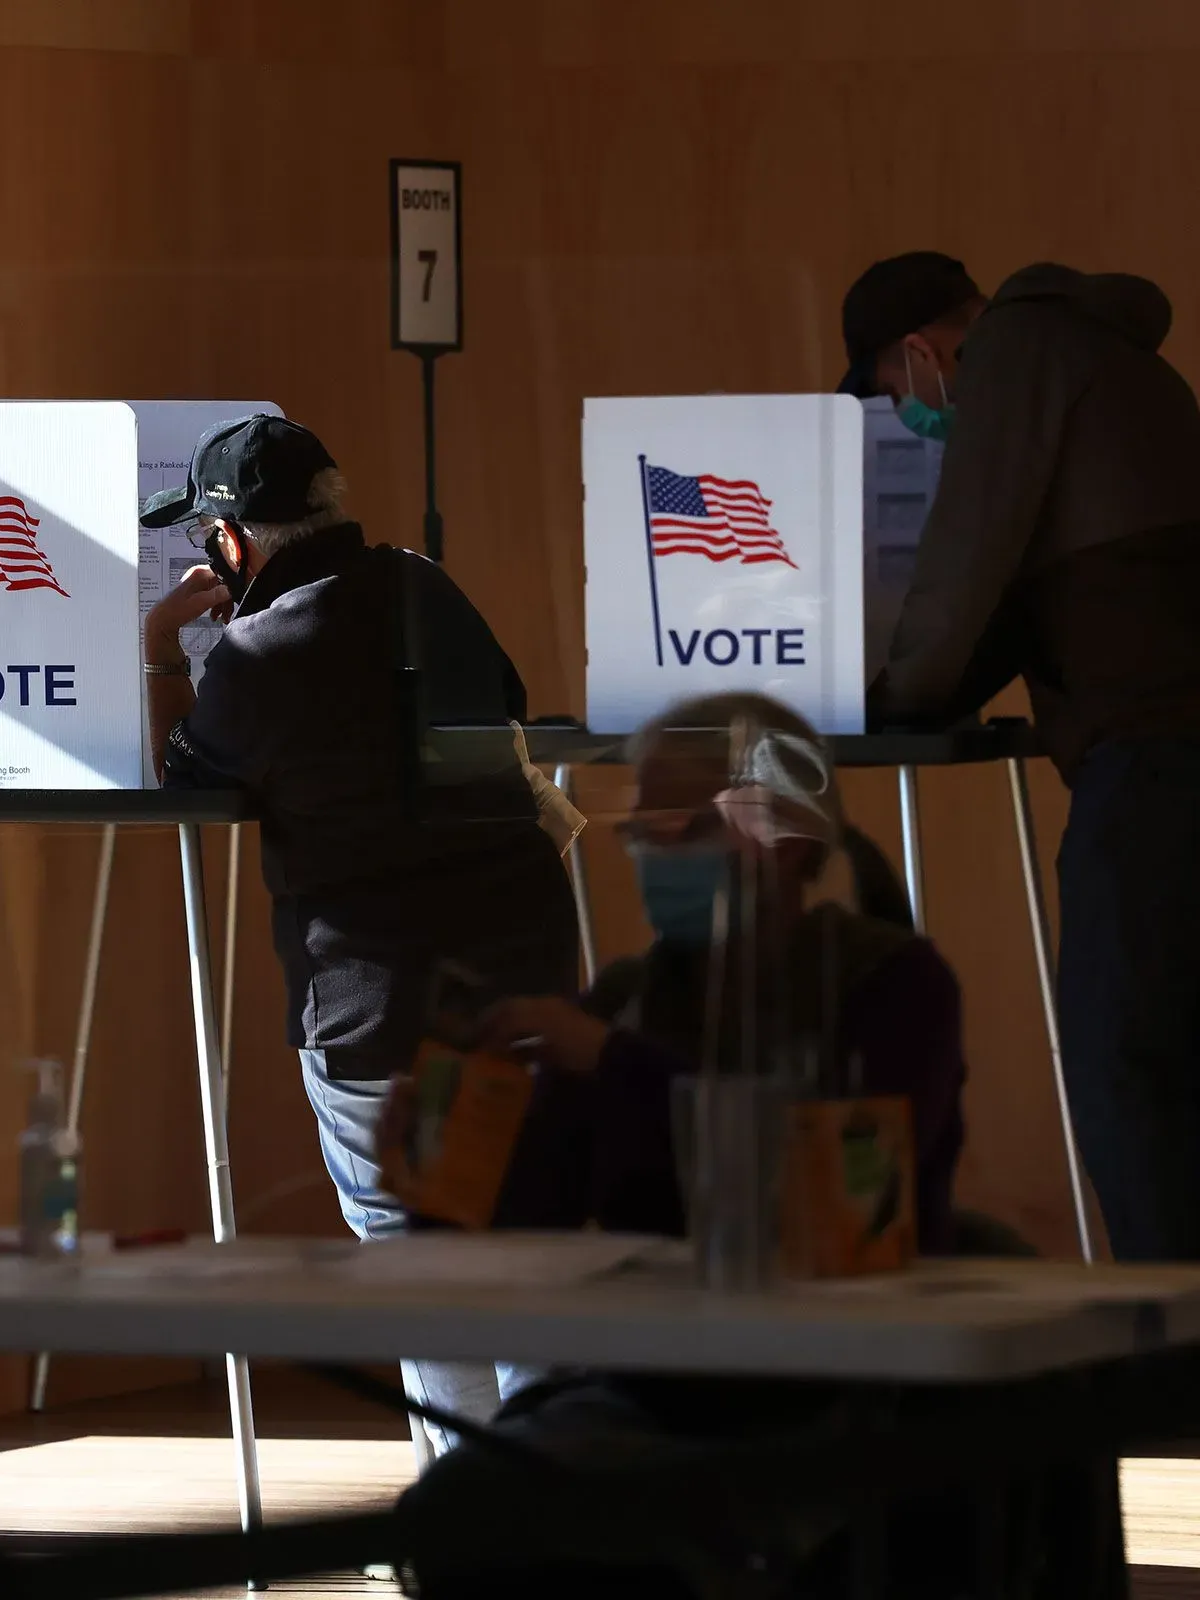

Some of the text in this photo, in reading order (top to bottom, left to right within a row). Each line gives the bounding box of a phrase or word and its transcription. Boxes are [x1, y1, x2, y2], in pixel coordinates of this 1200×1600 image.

[402, 188, 451, 211] BOOTH
[418, 250, 437, 302] 7
[668, 629, 806, 666] VOTE
[8, 766, 31, 774] Booth
